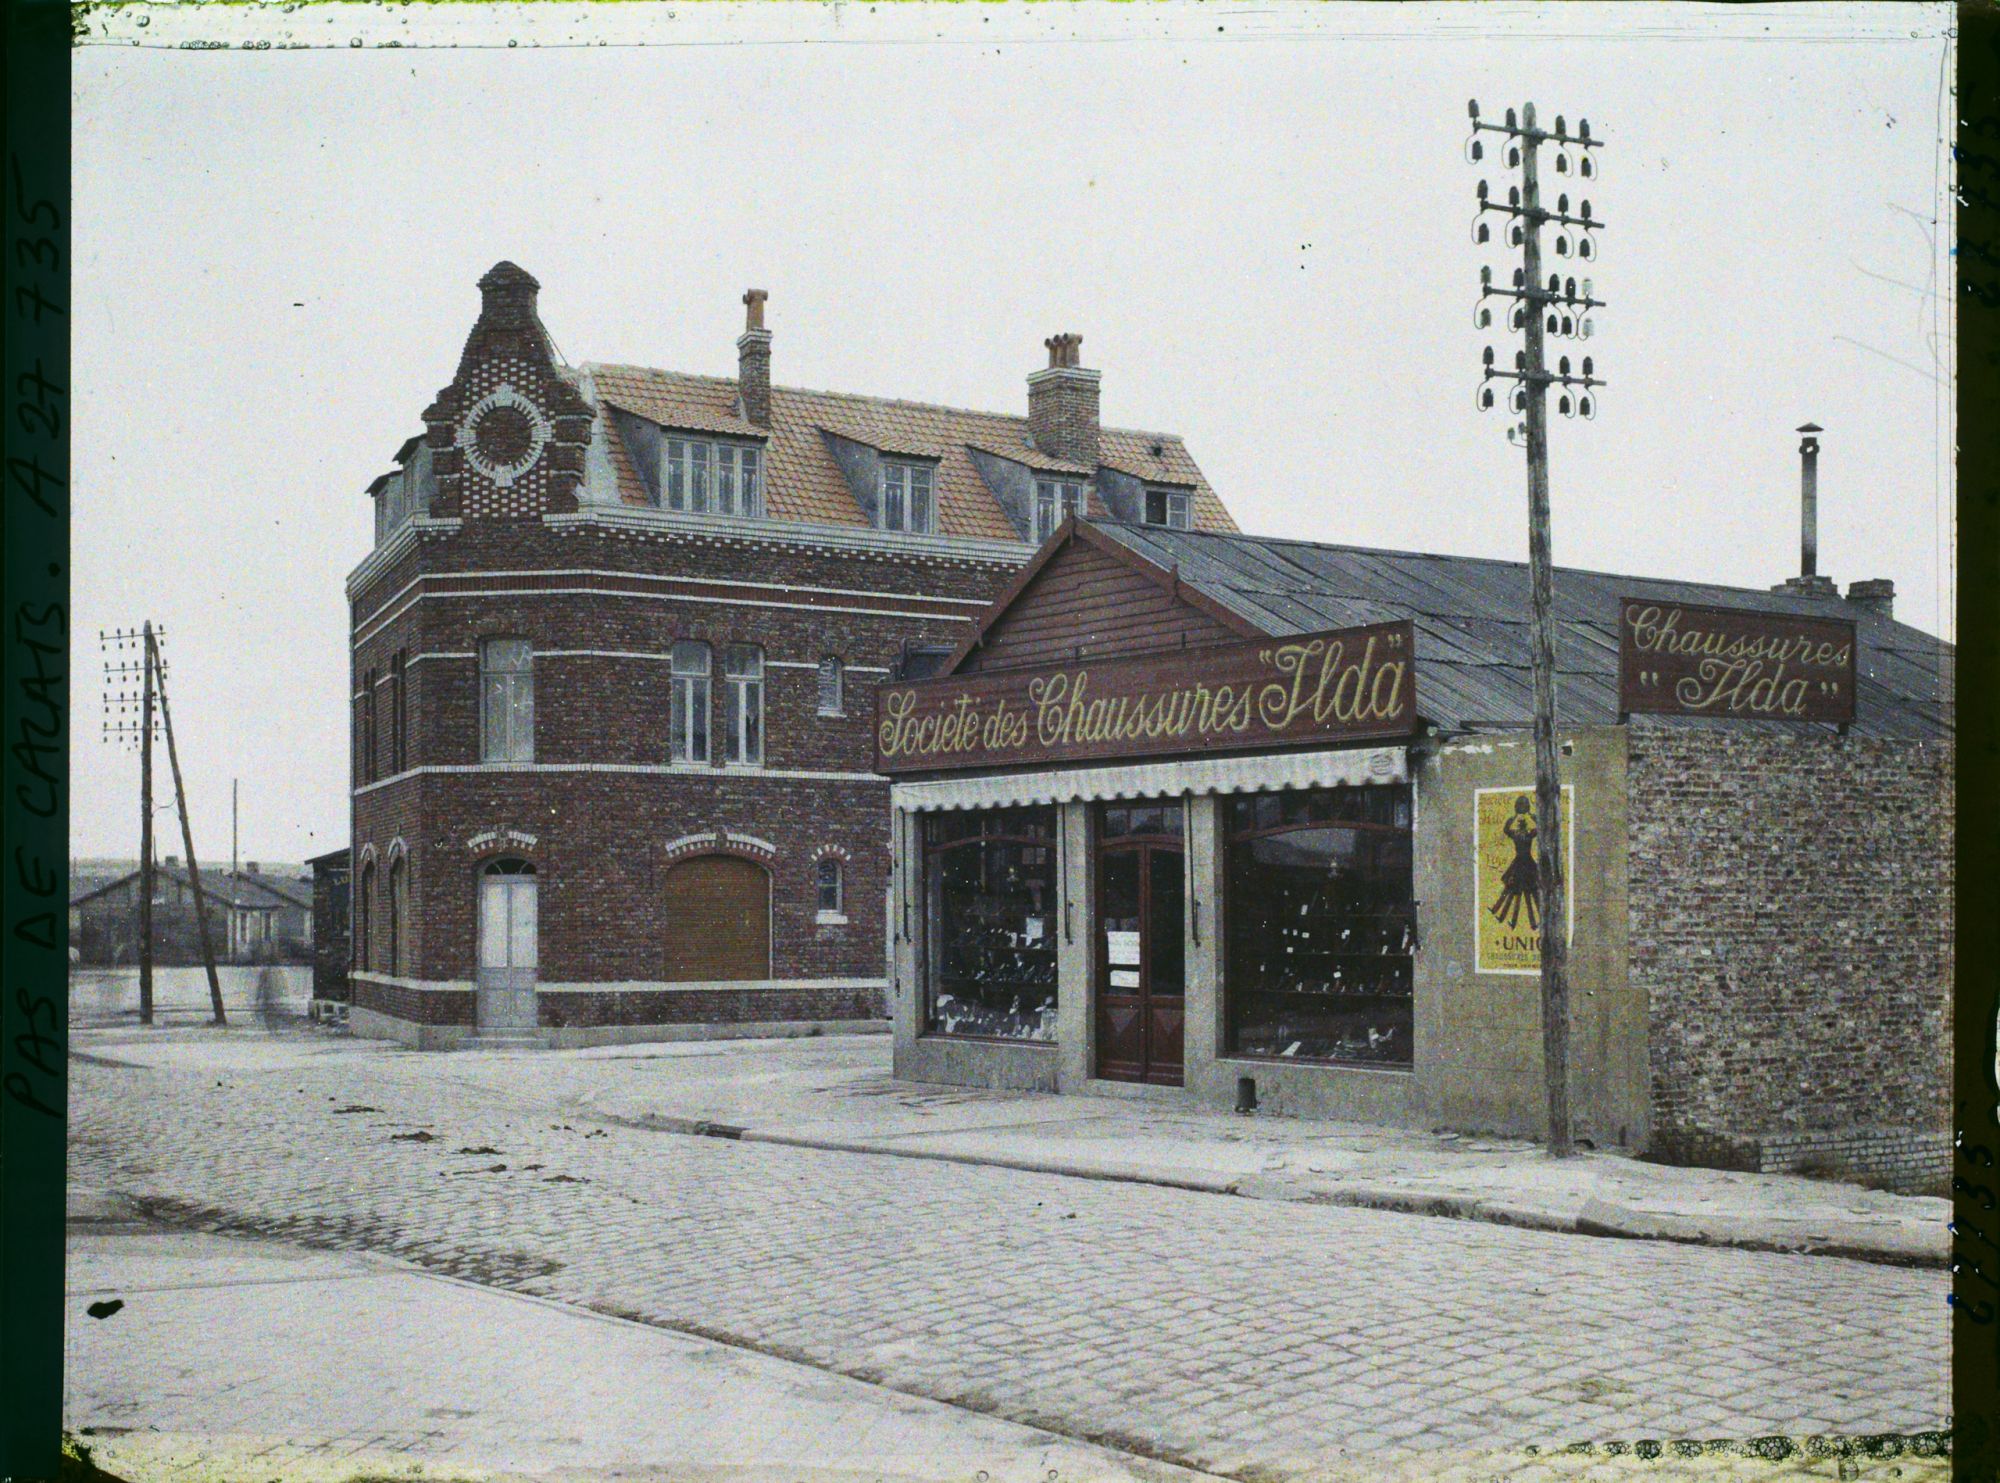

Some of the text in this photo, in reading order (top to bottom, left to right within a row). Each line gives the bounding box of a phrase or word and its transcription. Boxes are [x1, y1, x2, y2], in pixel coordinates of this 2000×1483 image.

[6, 454, 66, 519] A
[1626, 604, 1852, 667] Chaussures
[983, 699, 1029, 750] des
[1029, 671, 1253, 747] Chaussures
[14, 847, 58, 950] DE
[3, 987, 64, 1119] PAS
